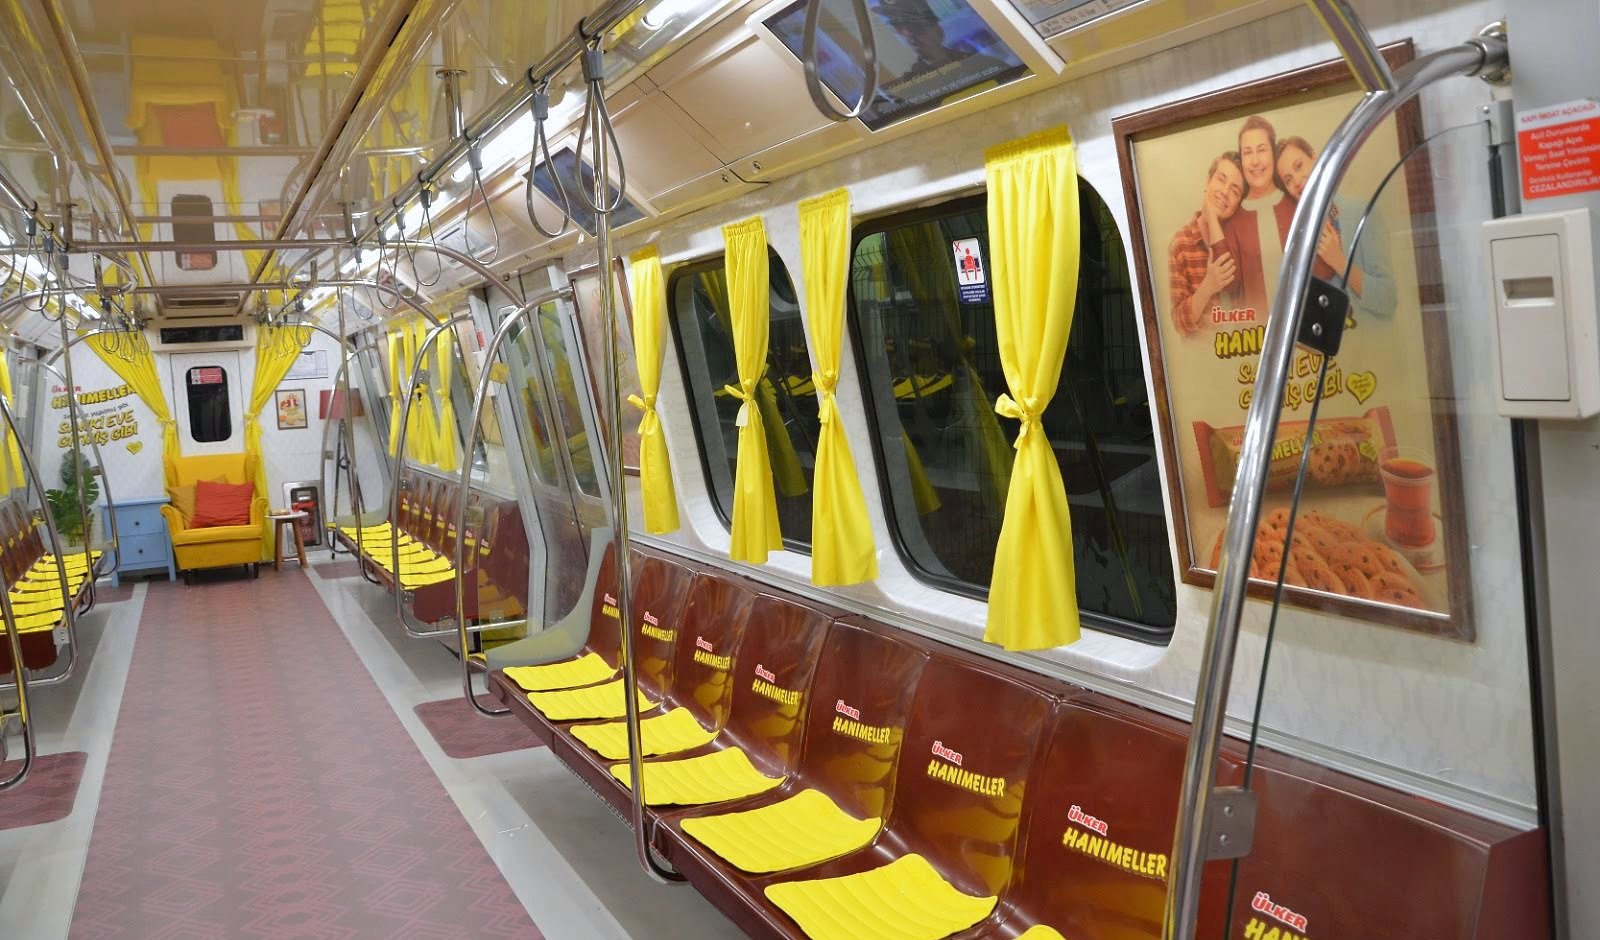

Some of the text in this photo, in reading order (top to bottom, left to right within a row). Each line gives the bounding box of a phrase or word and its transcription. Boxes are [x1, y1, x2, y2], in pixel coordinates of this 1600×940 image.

[1212, 305, 1256, 324] ÜLKER
[752, 678, 799, 706] HANIMELLER
[835, 699, 860, 721] ÜLKER
[832, 715, 890, 744] HANIMELLER
[932, 740, 963, 766] ÜLKER
[927, 759, 1005, 797] HANIMELLER
[1067, 804, 1108, 837] ÜLKER
[1062, 826, 1168, 877] HANIMELLER
[1251, 891, 1308, 934] ÜLKER
